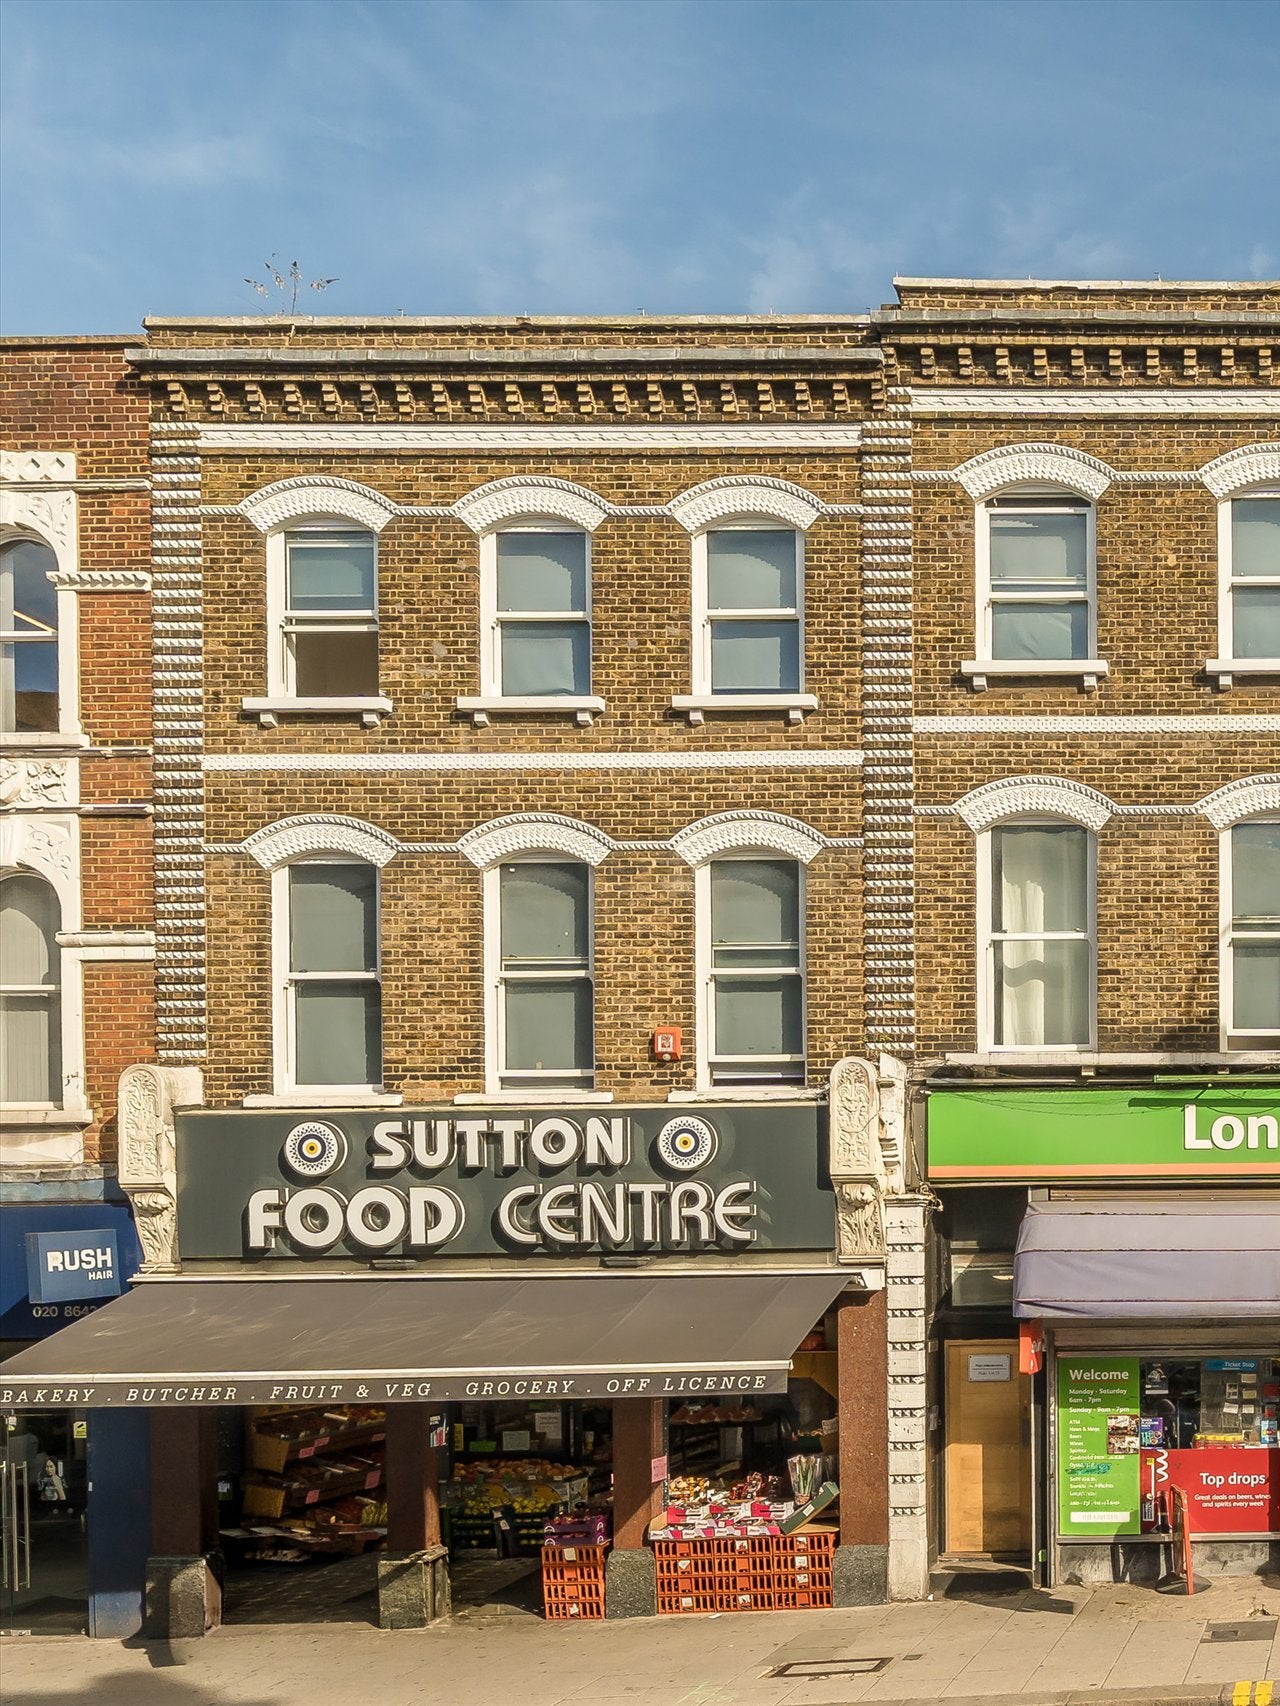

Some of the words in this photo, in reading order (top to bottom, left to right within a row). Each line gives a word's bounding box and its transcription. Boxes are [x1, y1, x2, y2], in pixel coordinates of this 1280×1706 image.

[372, 1116, 631, 1169] SUTTON
[248, 1185, 466, 1249] FOOD
[498, 1180, 757, 1244] CENTRE
[46, 1247, 113, 1273] RUSH
[88, 1270, 113, 1280] HAIR
[32, 1305, 59, 1318] 020
[1242, 1361, 1255, 1369] Stop
[1069, 1368, 1130, 1380] Welcome
[2, 1388, 95, 1403] BAKERY
[126, 1386, 238, 1402] BUTCHER
[270, 1384, 345, 1400] FRUIT
[356, 1384, 370, 1398] &
[385, 1382, 431, 1397] VEG
[465, 1379, 575, 1396] GROCERY
[606, 1378, 651, 1393] OFF
[663, 1375, 767, 1391] LICENCE
[1069, 1388, 1094, 1397] Monday
[1099, 1387, 1127, 1395] Saturday
[1069, 1406, 1092, 1414] Sunday
[1115, 1405, 1130, 1413] 7pm
[1199, 1472, 1225, 1488] Top
[1228, 1471, 1266, 1488] drops
